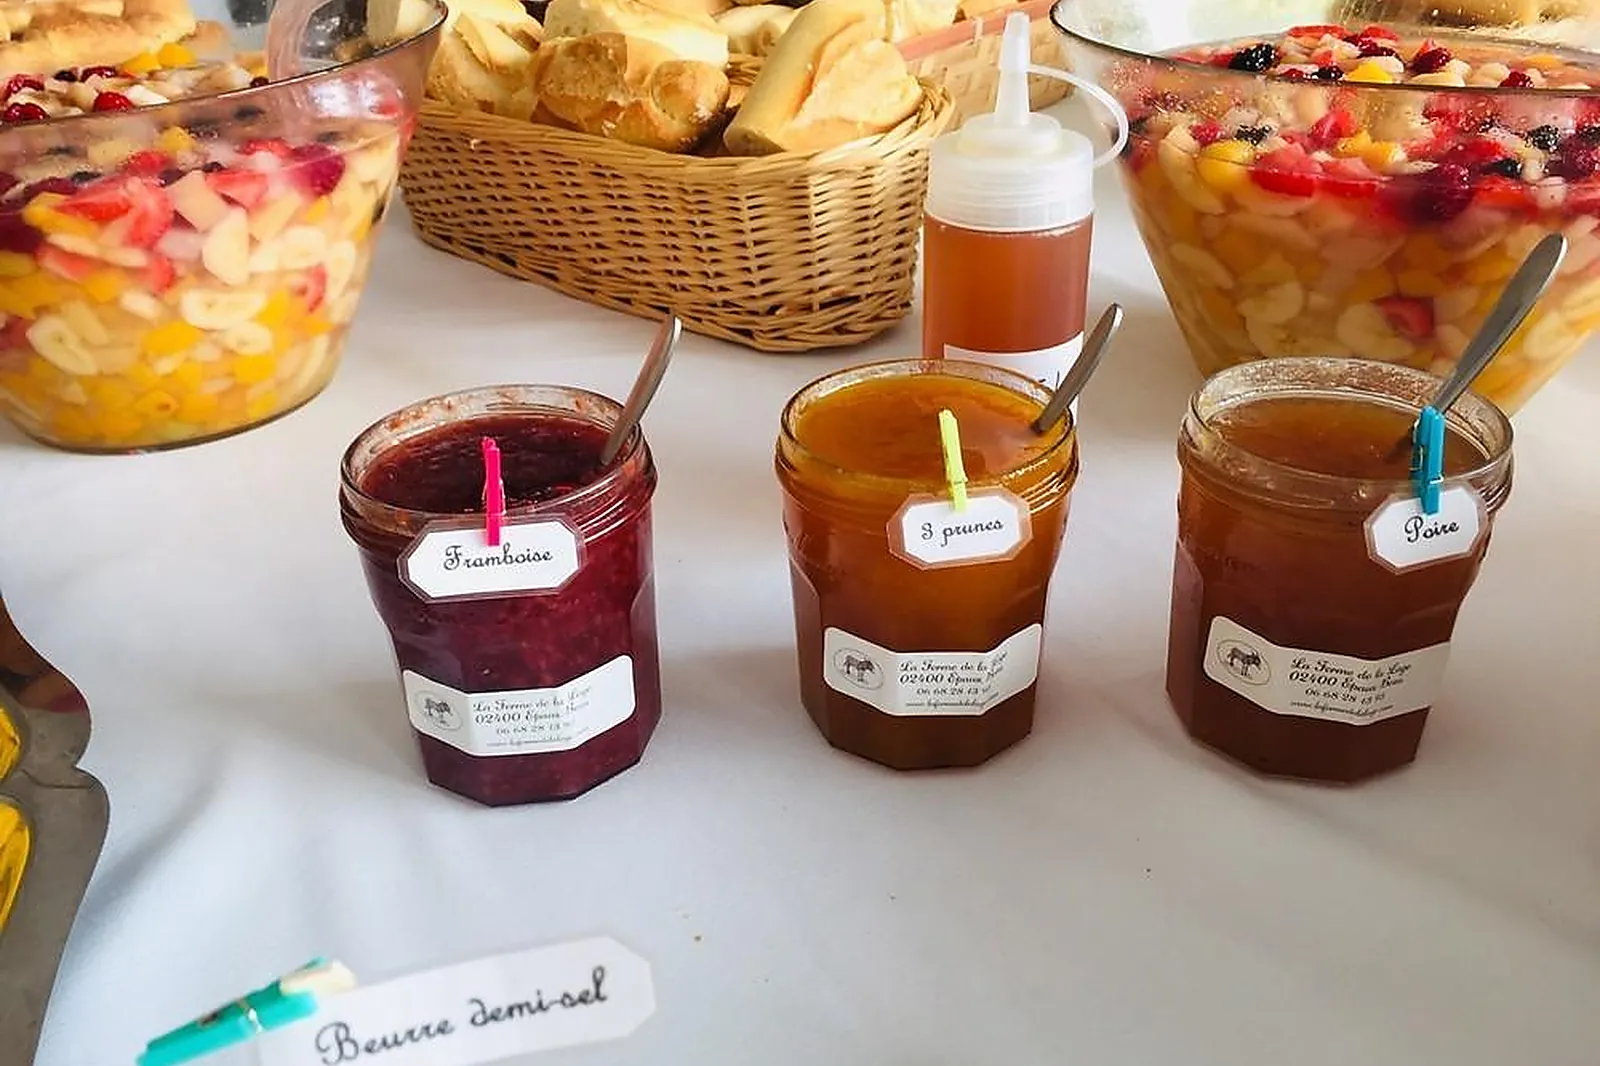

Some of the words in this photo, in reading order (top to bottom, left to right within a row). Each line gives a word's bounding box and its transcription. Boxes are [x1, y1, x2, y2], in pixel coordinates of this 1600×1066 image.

[940, 518, 1004, 548] prunes
[1403, 515, 1460, 544] Poire
[443, 542, 554, 571] Framboise
[899, 673, 945, 685] 02400
[1289, 669, 1338, 687] 02400
[474, 711, 522, 726] 02400
[314, 1016, 455, 1066] Beurre
[469, 965, 608, 1028] demi-sel
